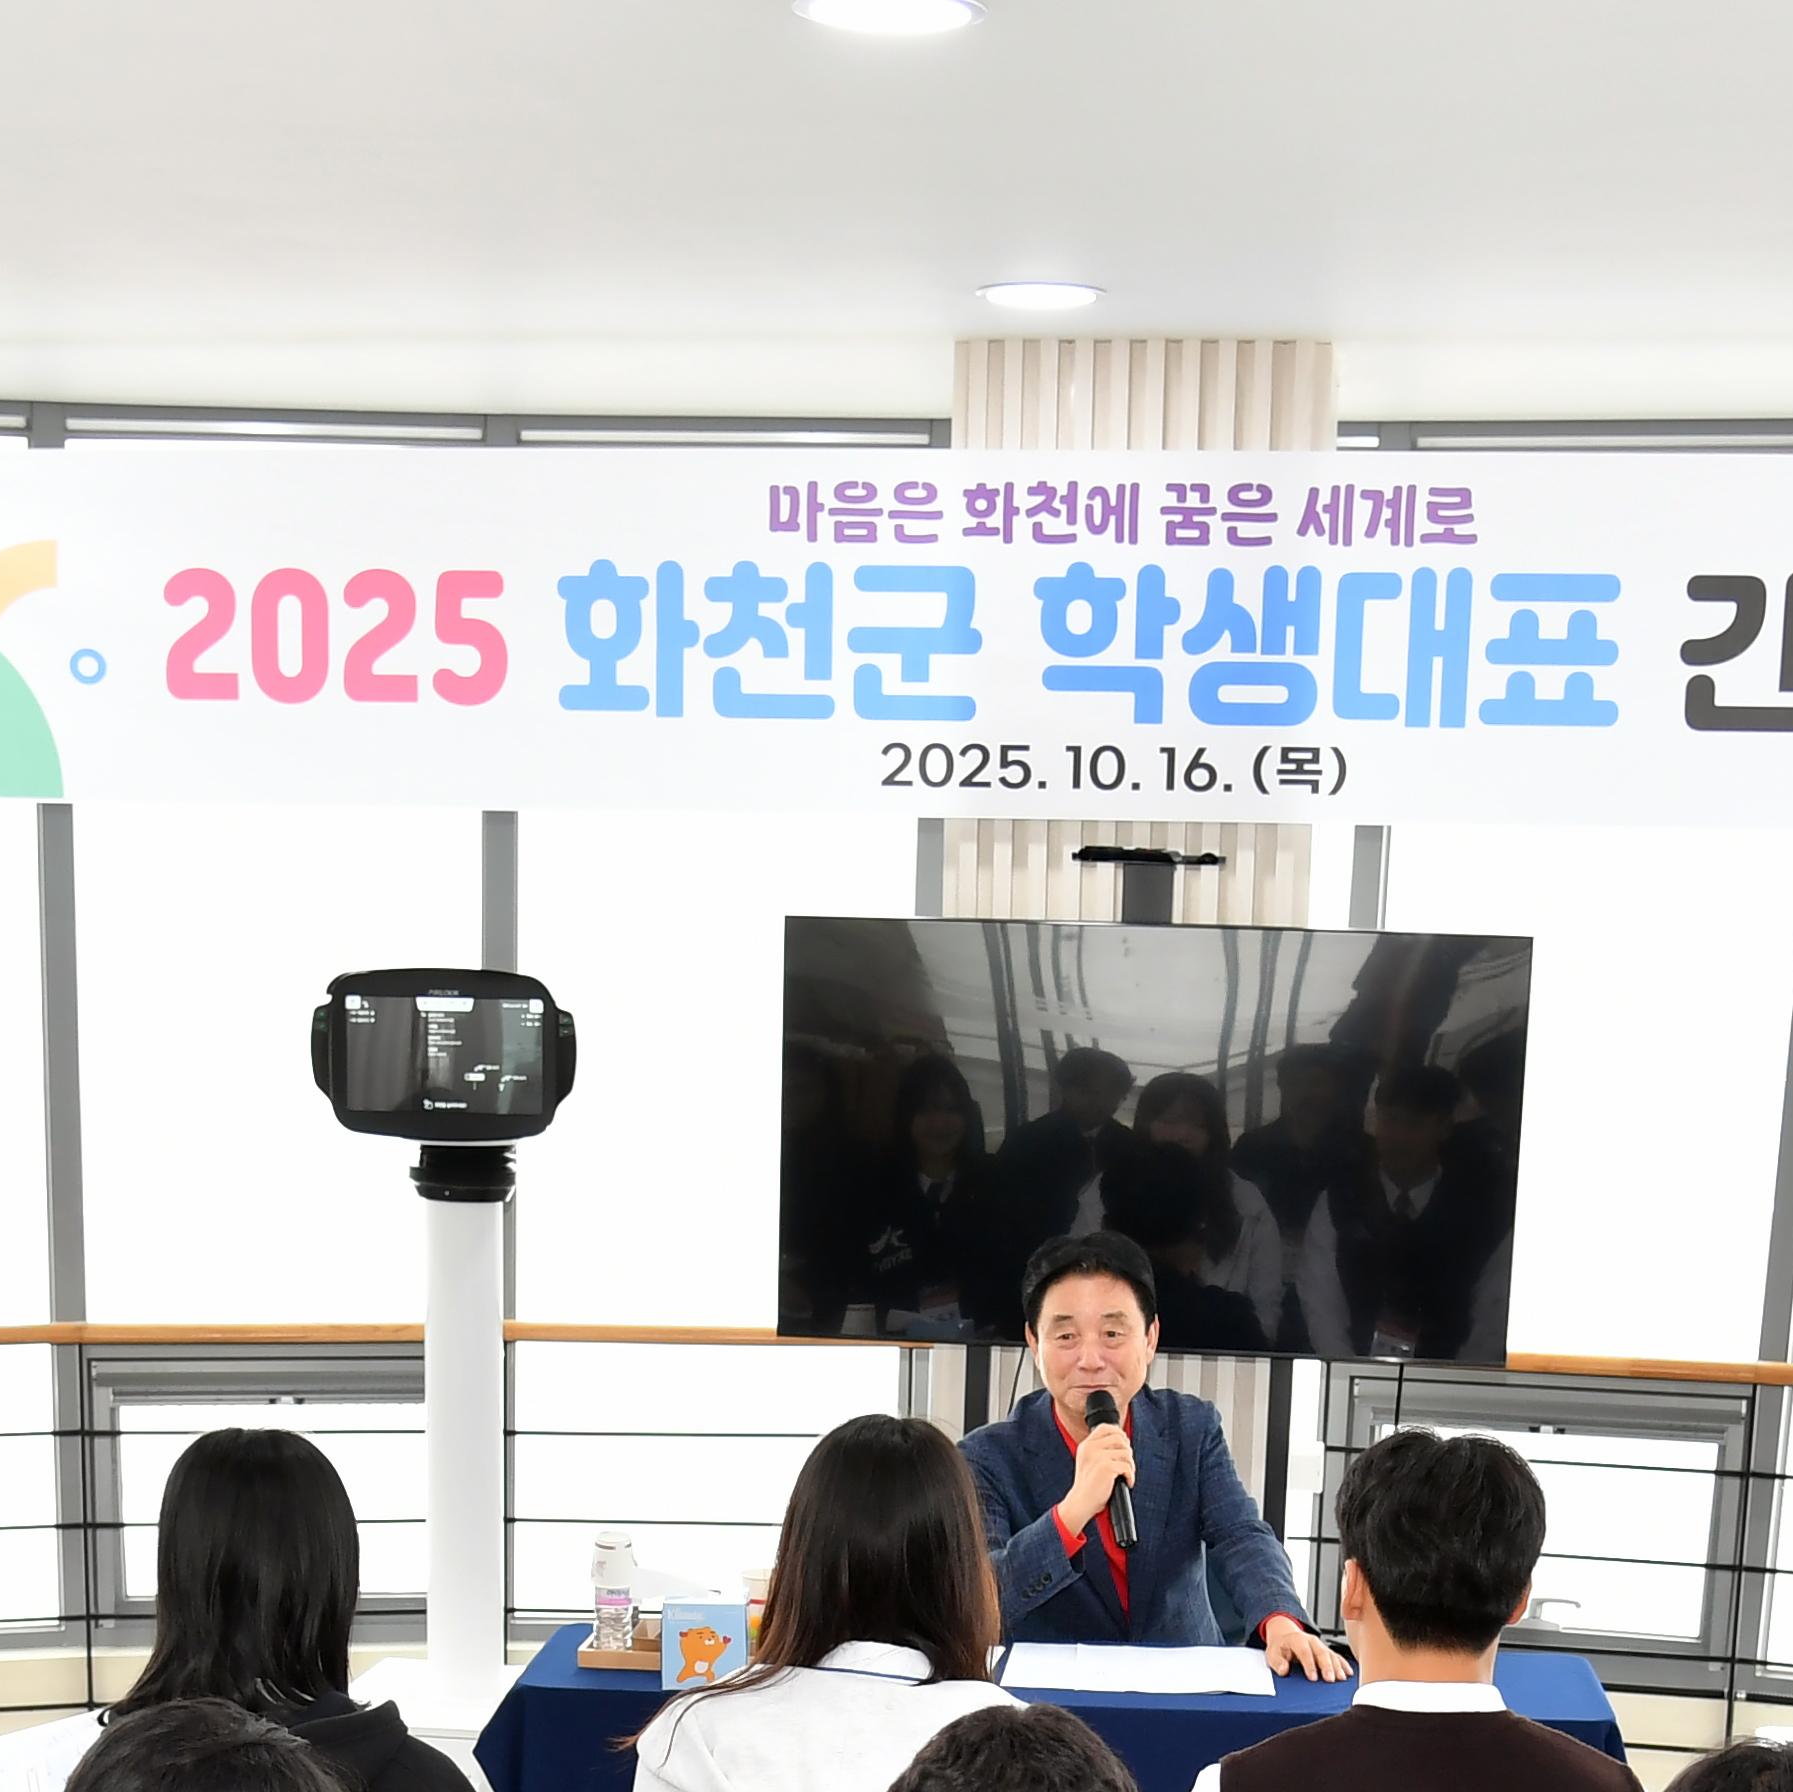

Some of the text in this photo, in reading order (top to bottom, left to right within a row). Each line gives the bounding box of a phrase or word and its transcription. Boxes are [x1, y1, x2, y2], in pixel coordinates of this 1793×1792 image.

[769, 480, 1478, 548] 마음은 화천에 꿈은 세계로
[163, 567, 508, 706] 2025
[557, 558, 983, 722] 화천군
[1033, 561, 1622, 729] 학생대표
[881, 742, 1347, 796] 2025. 10. 16. (목)
